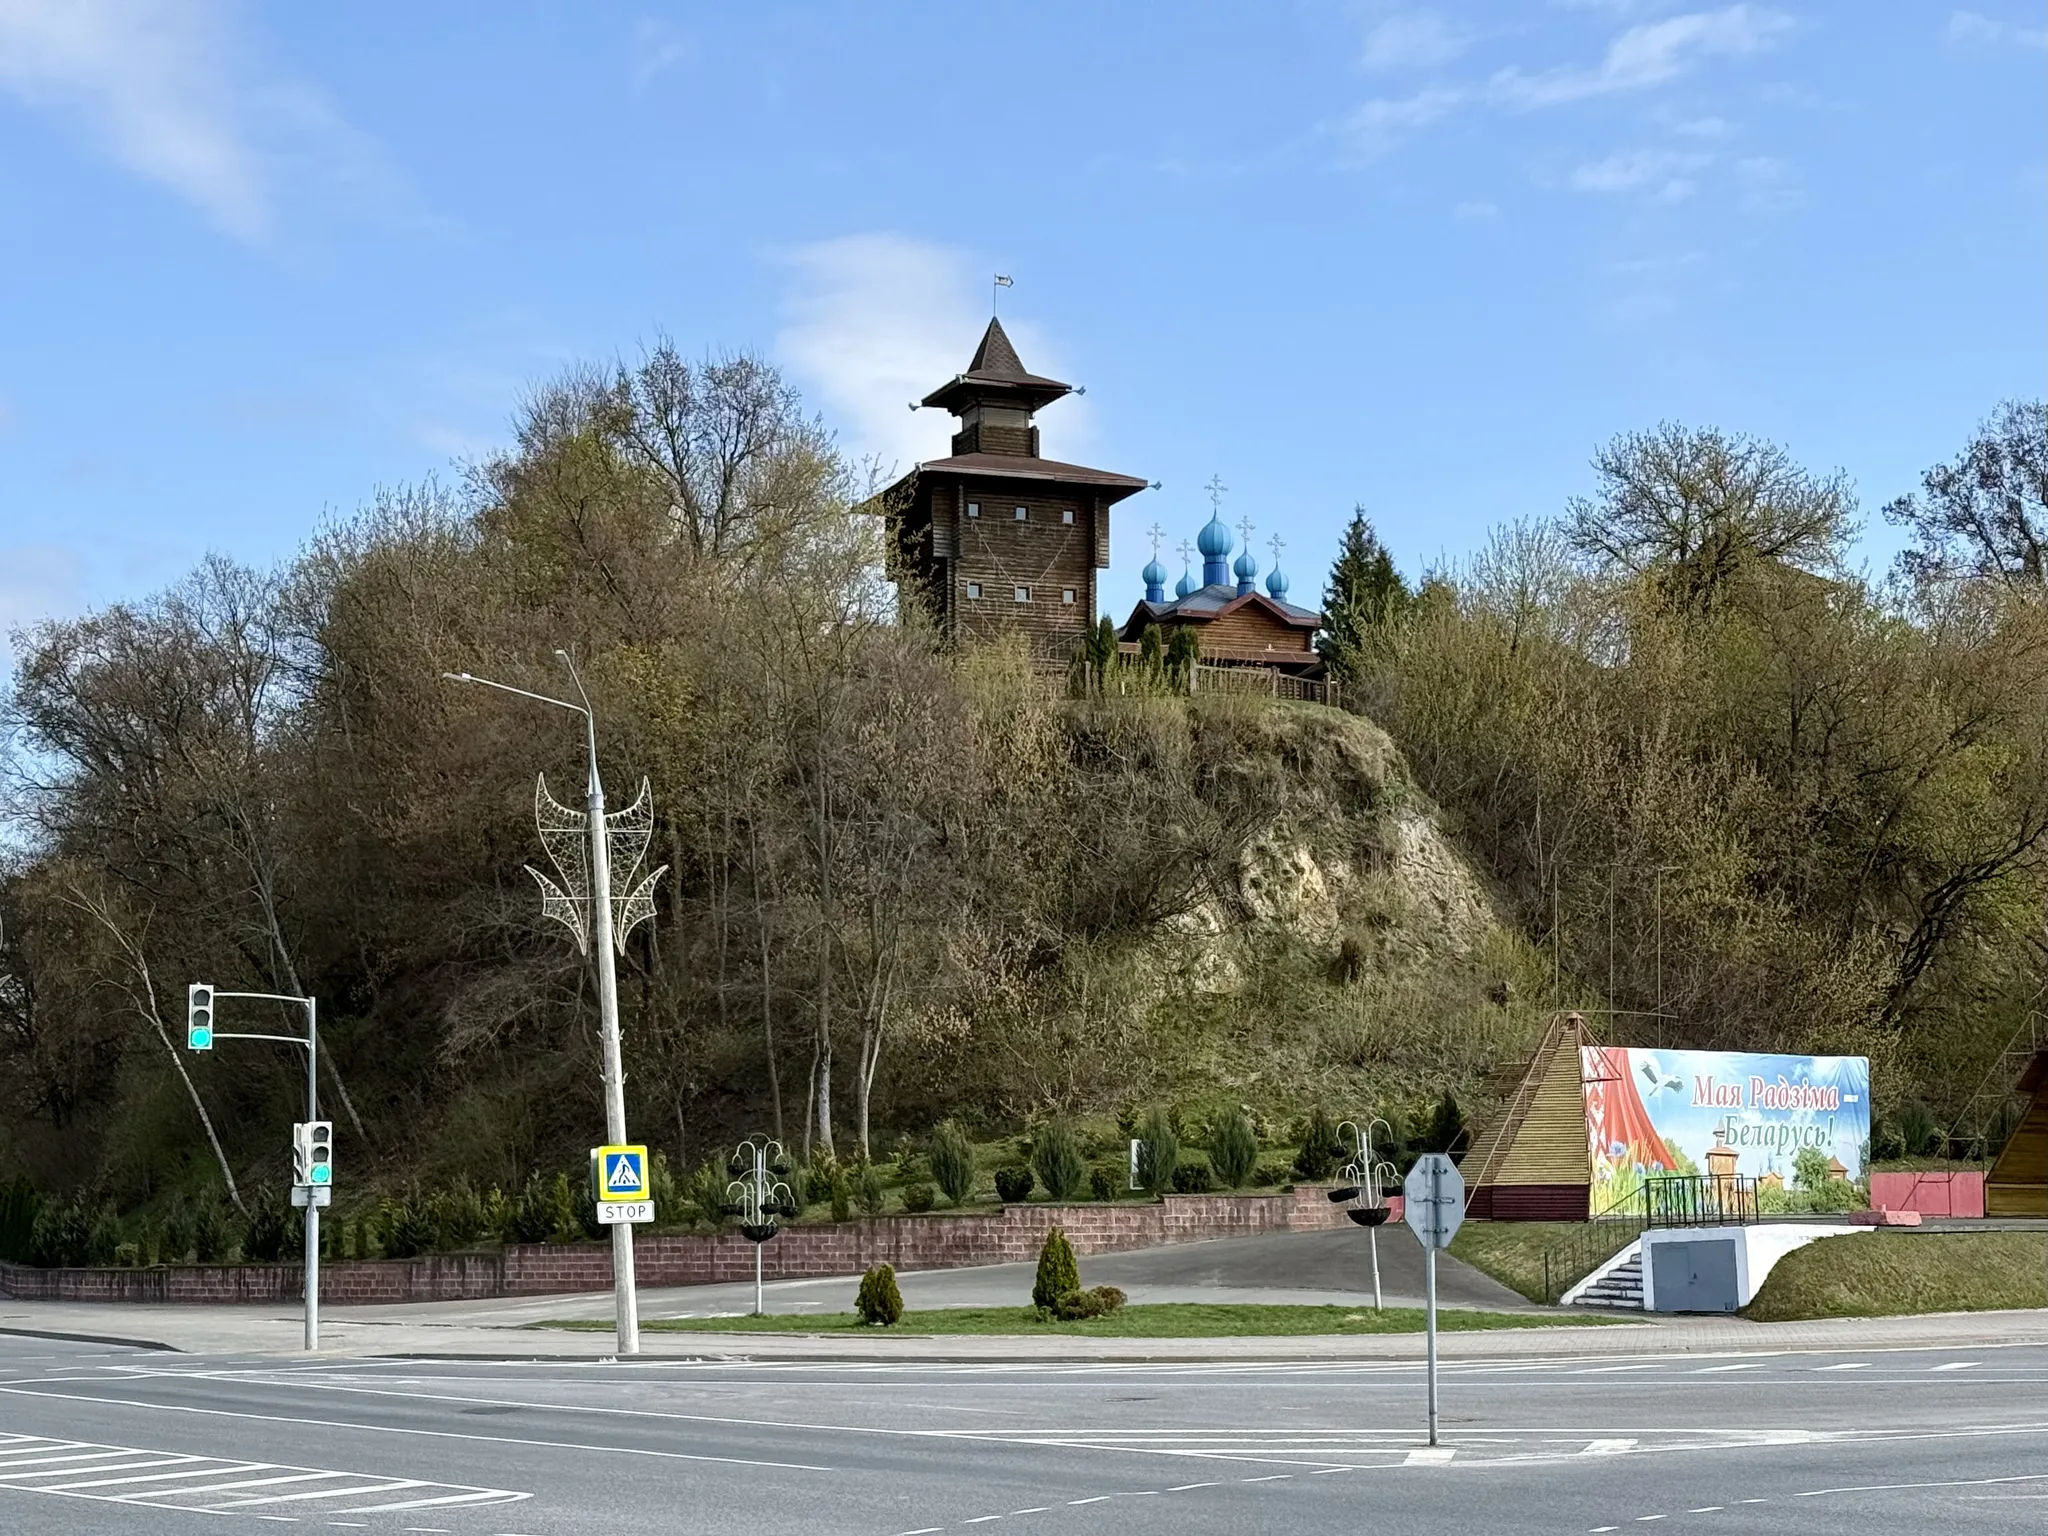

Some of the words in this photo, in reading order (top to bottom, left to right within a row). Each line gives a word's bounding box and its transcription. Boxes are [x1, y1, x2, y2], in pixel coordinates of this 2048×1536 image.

[1691, 1075, 1742, 1107] Мая
[1749, 1076, 1839, 1109] Радзіма
[1724, 1115, 1834, 1156] Беларусь!
[605, 1205, 646, 1219] STOP
